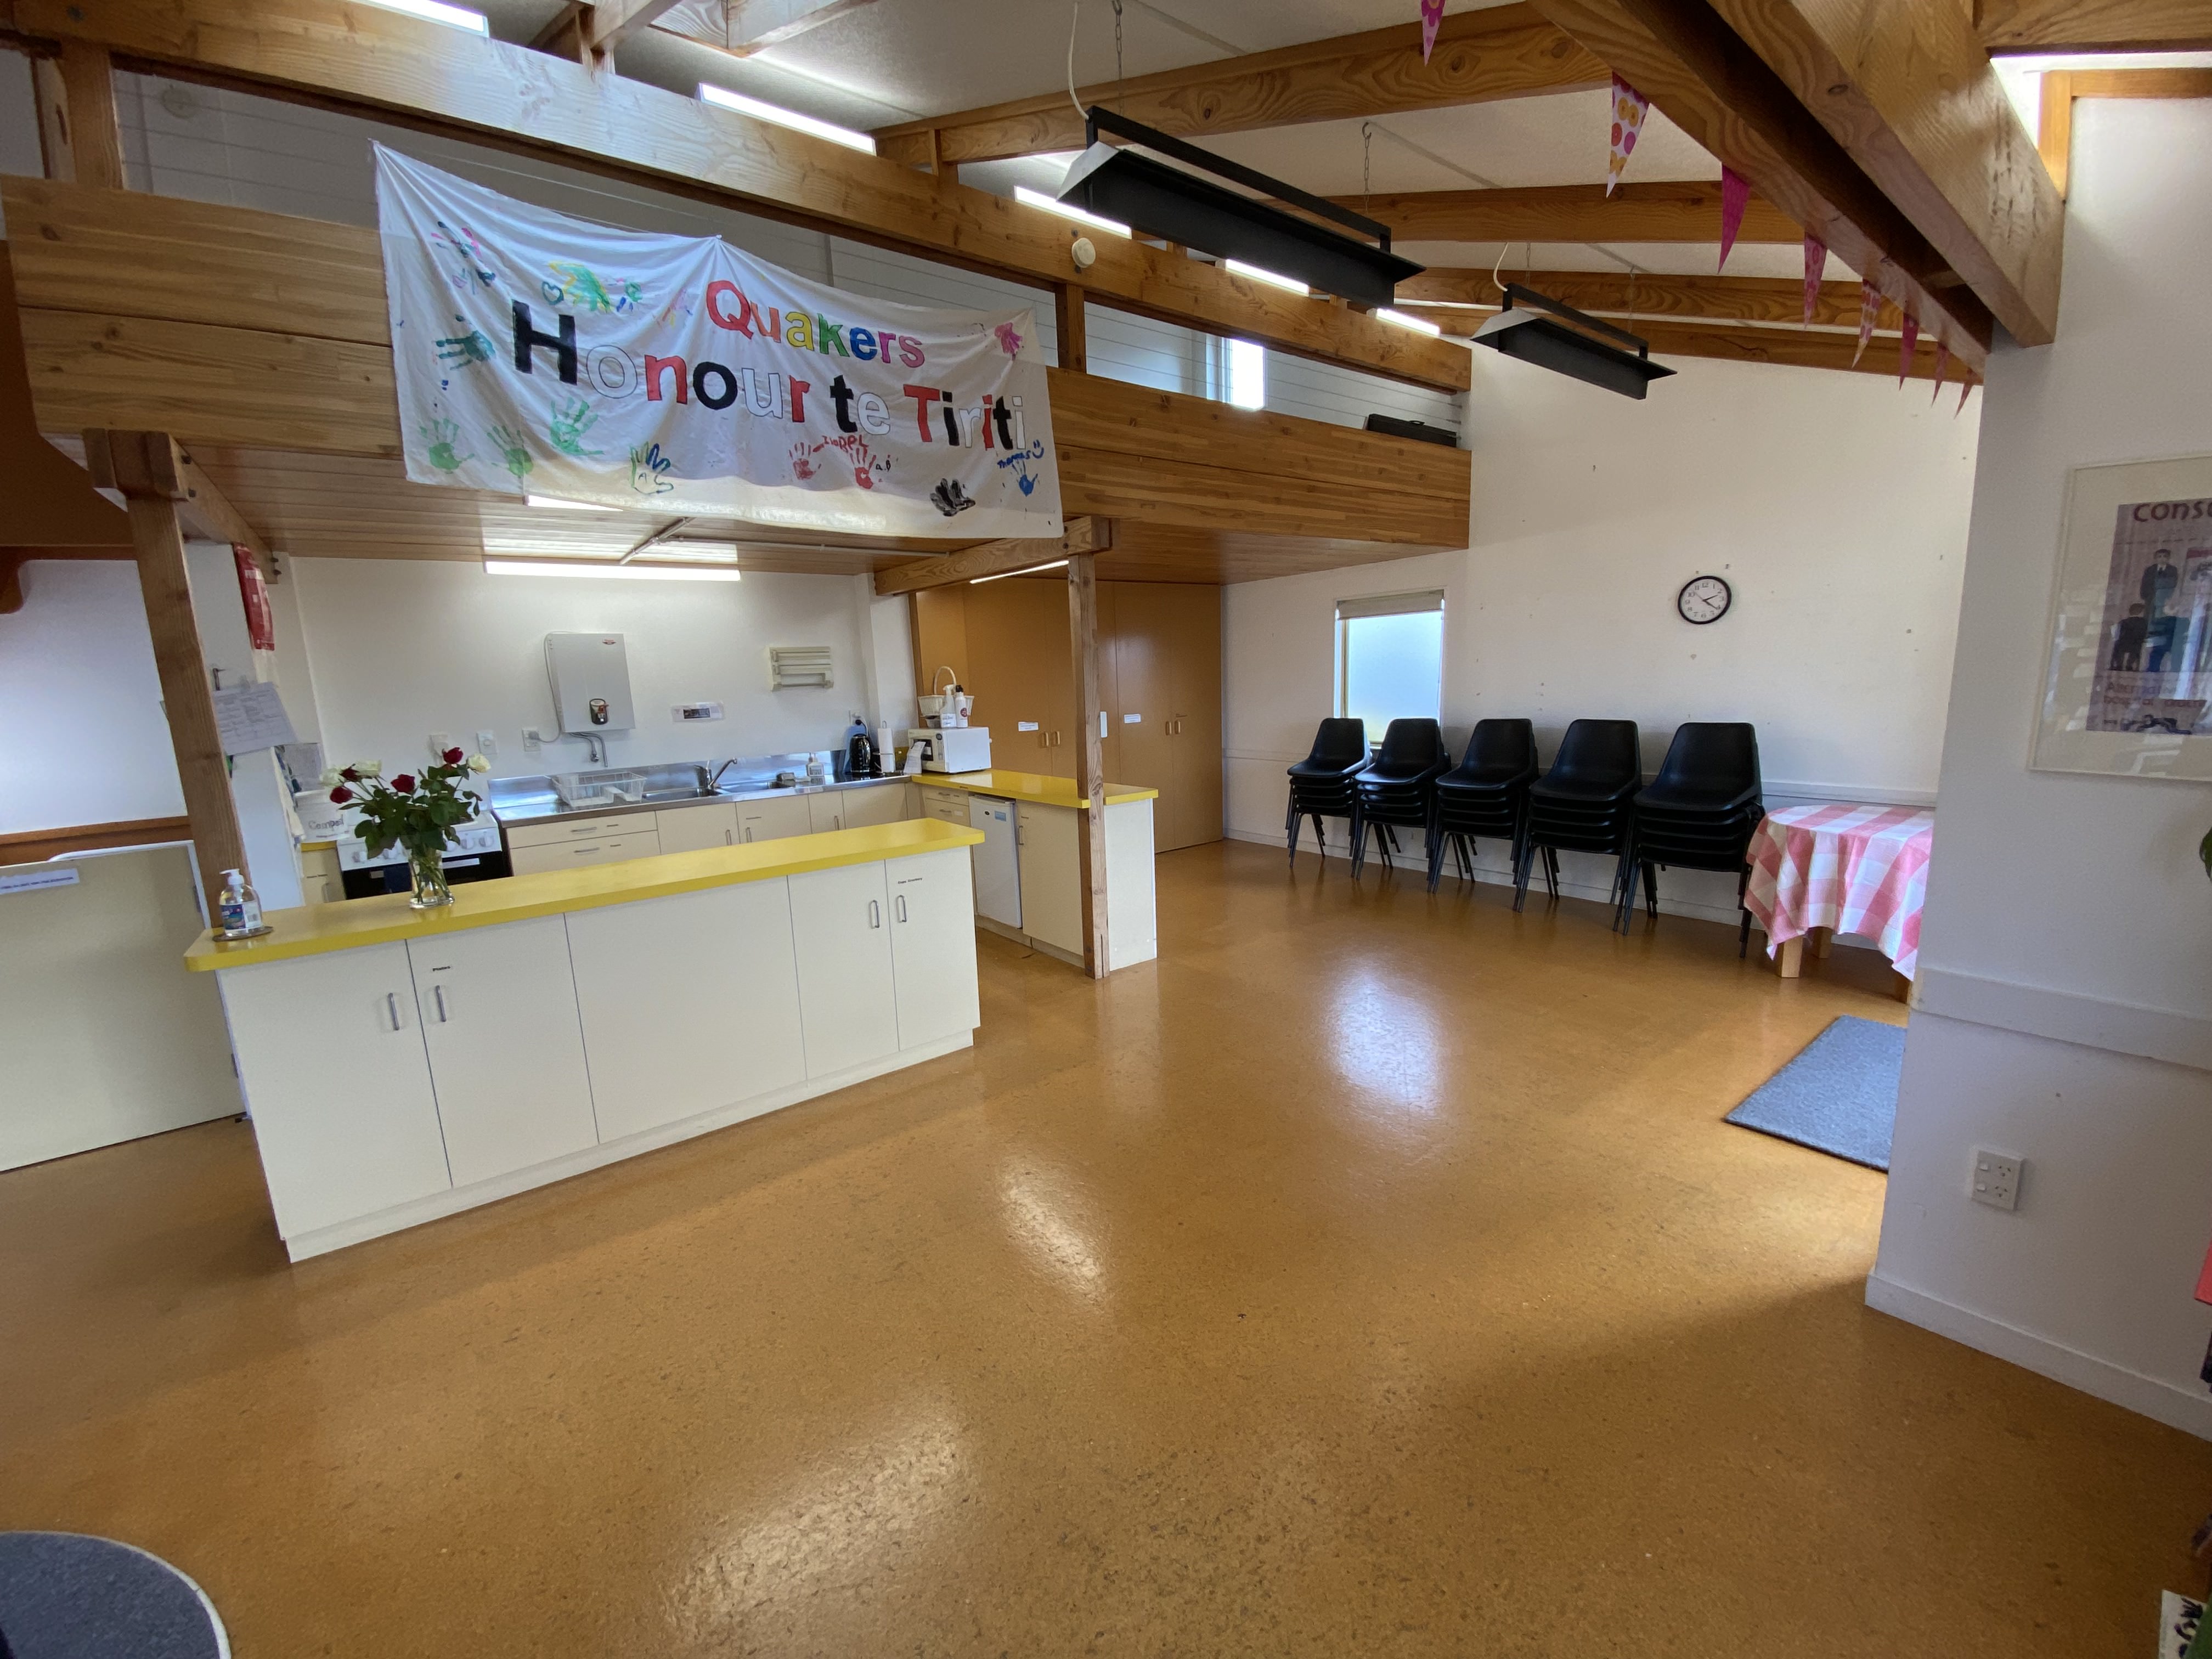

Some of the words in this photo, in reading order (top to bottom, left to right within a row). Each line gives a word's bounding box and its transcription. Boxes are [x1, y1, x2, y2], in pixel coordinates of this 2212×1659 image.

[511, 299, 811, 423] Honour
[830, 375, 891, 436] te
[903, 383, 1026, 450] Tiriti
[706, 280, 926, 368] Quakers
